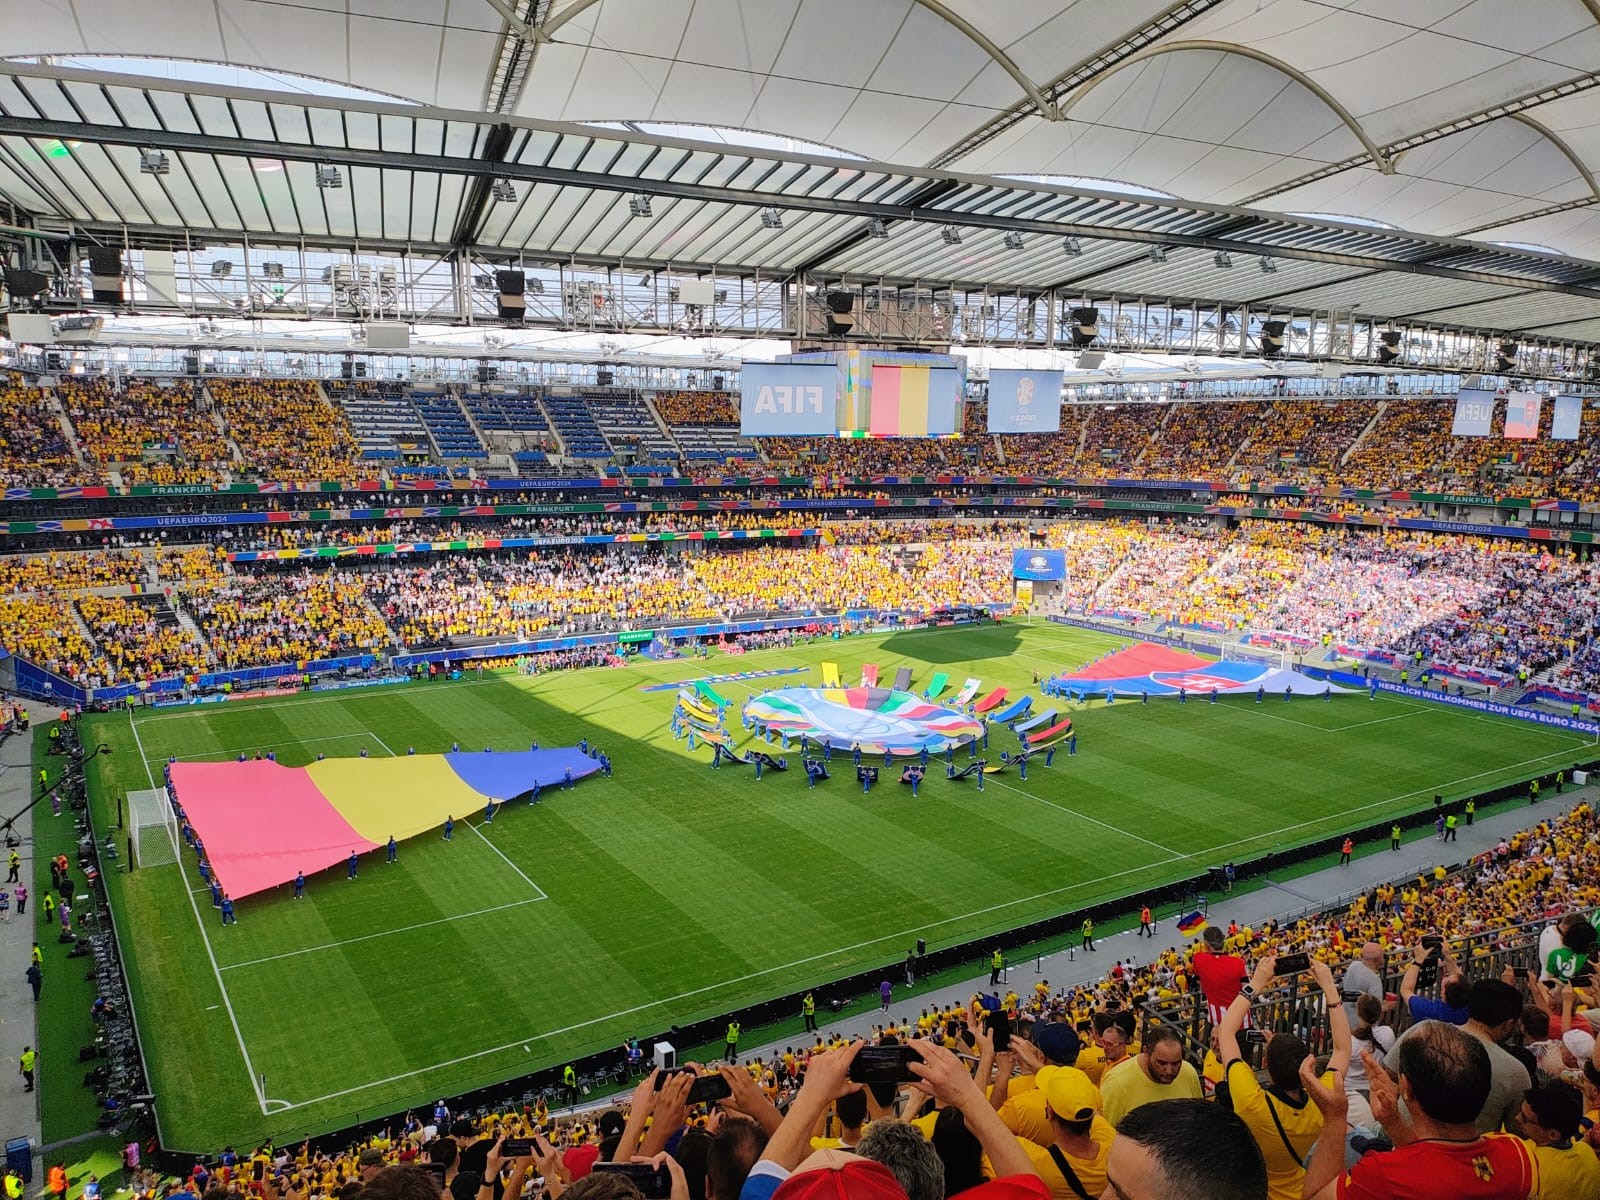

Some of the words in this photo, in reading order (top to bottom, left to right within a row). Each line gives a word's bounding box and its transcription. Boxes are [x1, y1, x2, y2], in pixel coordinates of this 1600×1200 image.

[152, 486, 217, 494] FRANKFUR
[1378, 682, 1421, 695] HERZLICH
[1421, 690, 1486, 709] WILLKOMMEN
[1488, 704, 1509, 714] ZUR
[1510, 708, 1537, 720] UEFA
[1539, 714, 1569, 726] EURO
[1570, 720, 1600, 733] 2024
